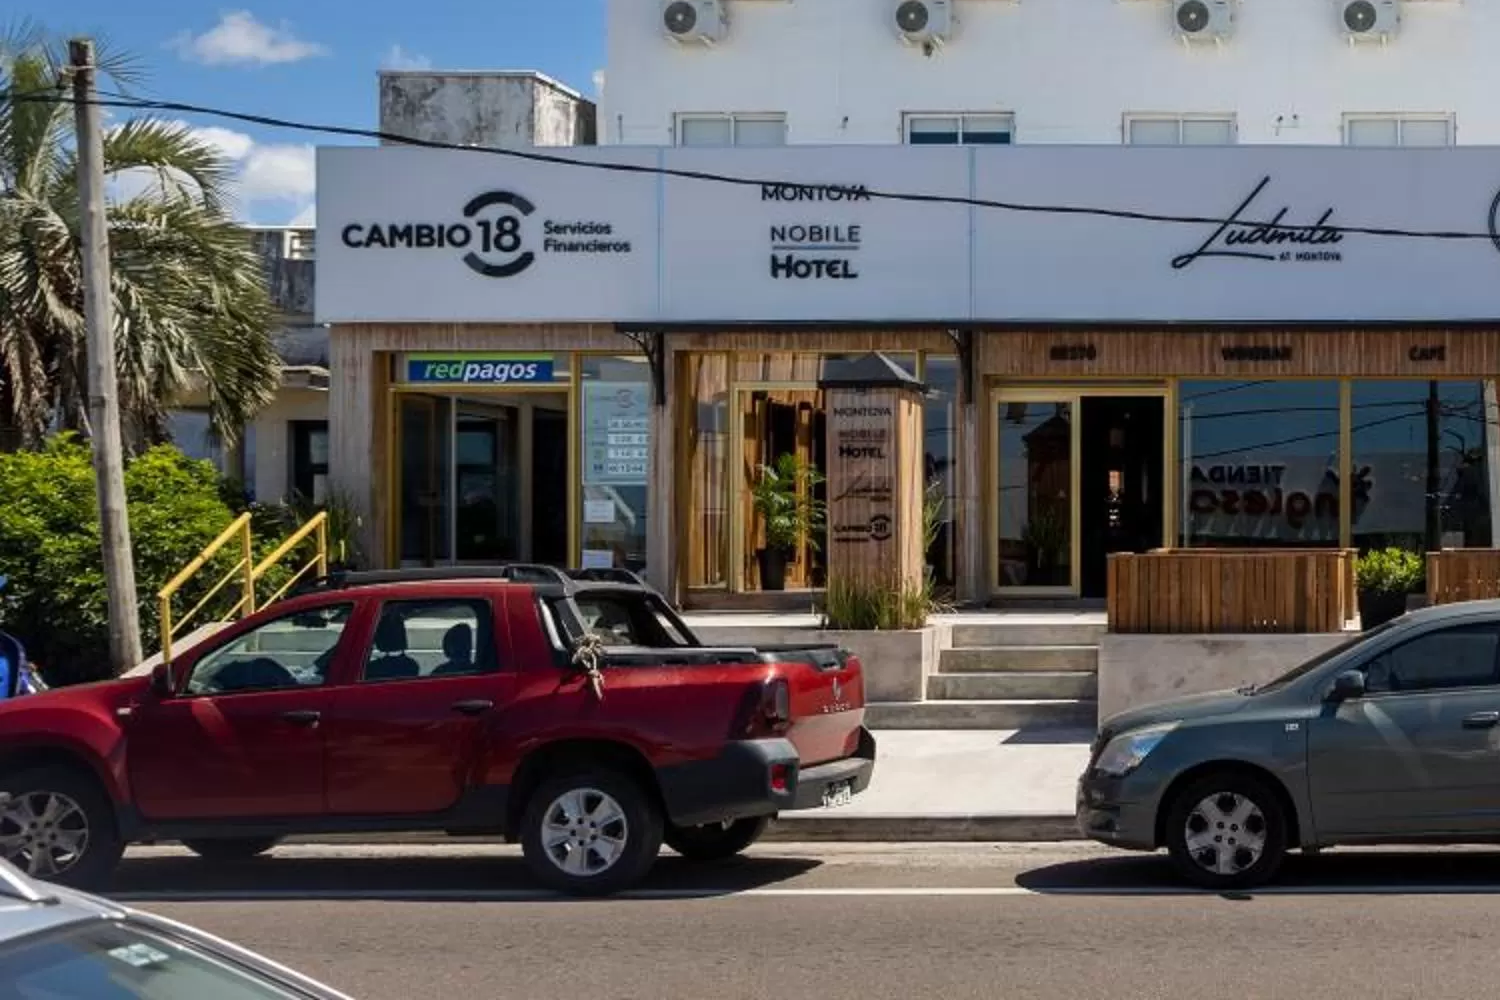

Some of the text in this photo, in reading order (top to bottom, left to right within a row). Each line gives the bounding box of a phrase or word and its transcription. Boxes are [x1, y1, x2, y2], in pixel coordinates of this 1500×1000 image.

[761, 183, 871, 201] MONTOYA
[543, 220, 612, 235] Servicios
[1171, 175, 1344, 269] Ludmila
[341, 215, 522, 252] CAMBIO 18
[770, 225, 862, 242] NOBILE
[543, 239, 632, 253] Financieros
[770, 254, 859, 279] HOTEL
[423, 361, 537, 382] redpagos
